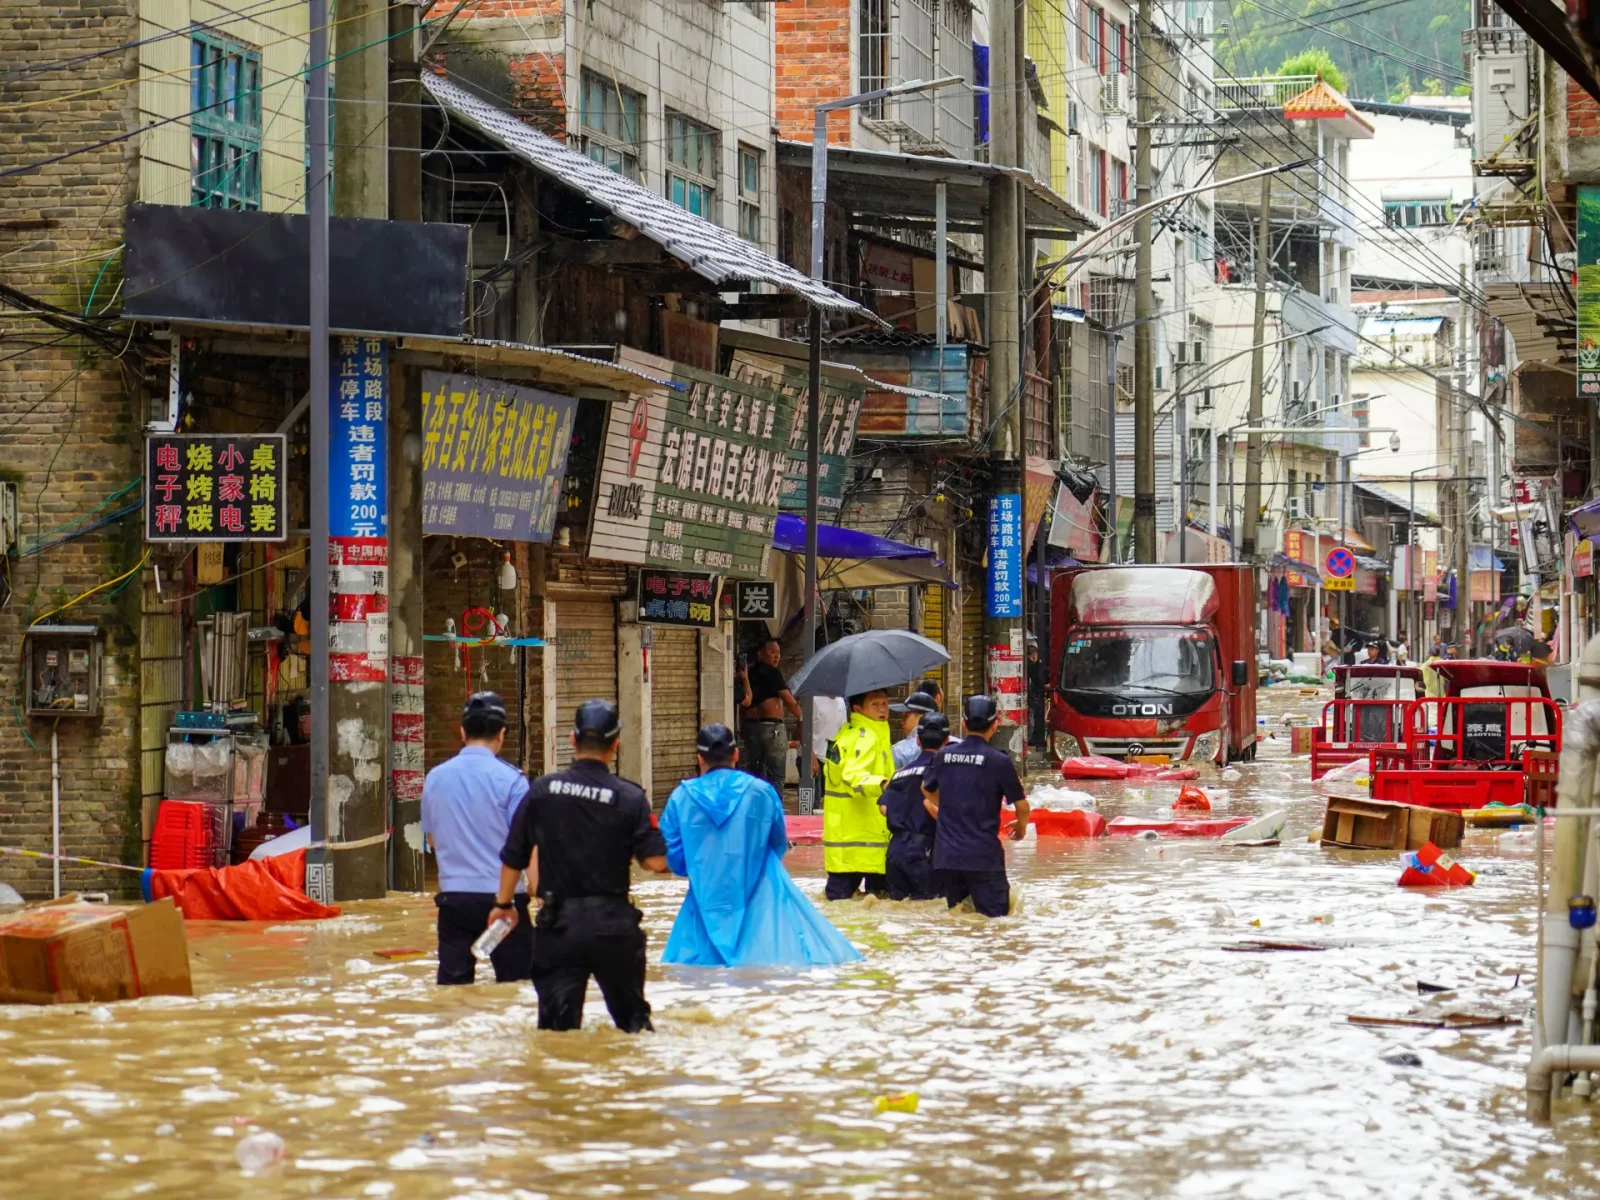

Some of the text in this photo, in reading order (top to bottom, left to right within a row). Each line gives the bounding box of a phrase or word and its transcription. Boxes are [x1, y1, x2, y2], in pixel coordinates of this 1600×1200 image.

[340, 336, 360, 422] 禁止停车
[363, 337, 383, 422] 市场路段
[688, 382, 776, 439] 公牛安全插座
[155, 444, 182, 533] 电子秤
[186, 444, 213, 533] 烧烤碳
[218, 444, 246, 533] 小家电
[249, 444, 277, 533] 桌椅凳
[348, 425, 377, 537] 违者罚款200元
[660, 427, 785, 507] 宏源日用百货批发
[990, 498, 999, 548] 禁止停车
[1001, 498, 1014, 548] 市场路段
[645, 598, 712, 623] 桌椅碗
[646, 575, 712, 600] 电子秤
[742, 586, 770, 614] 炭
[994, 549, 1011, 614] 违者罚款200元
